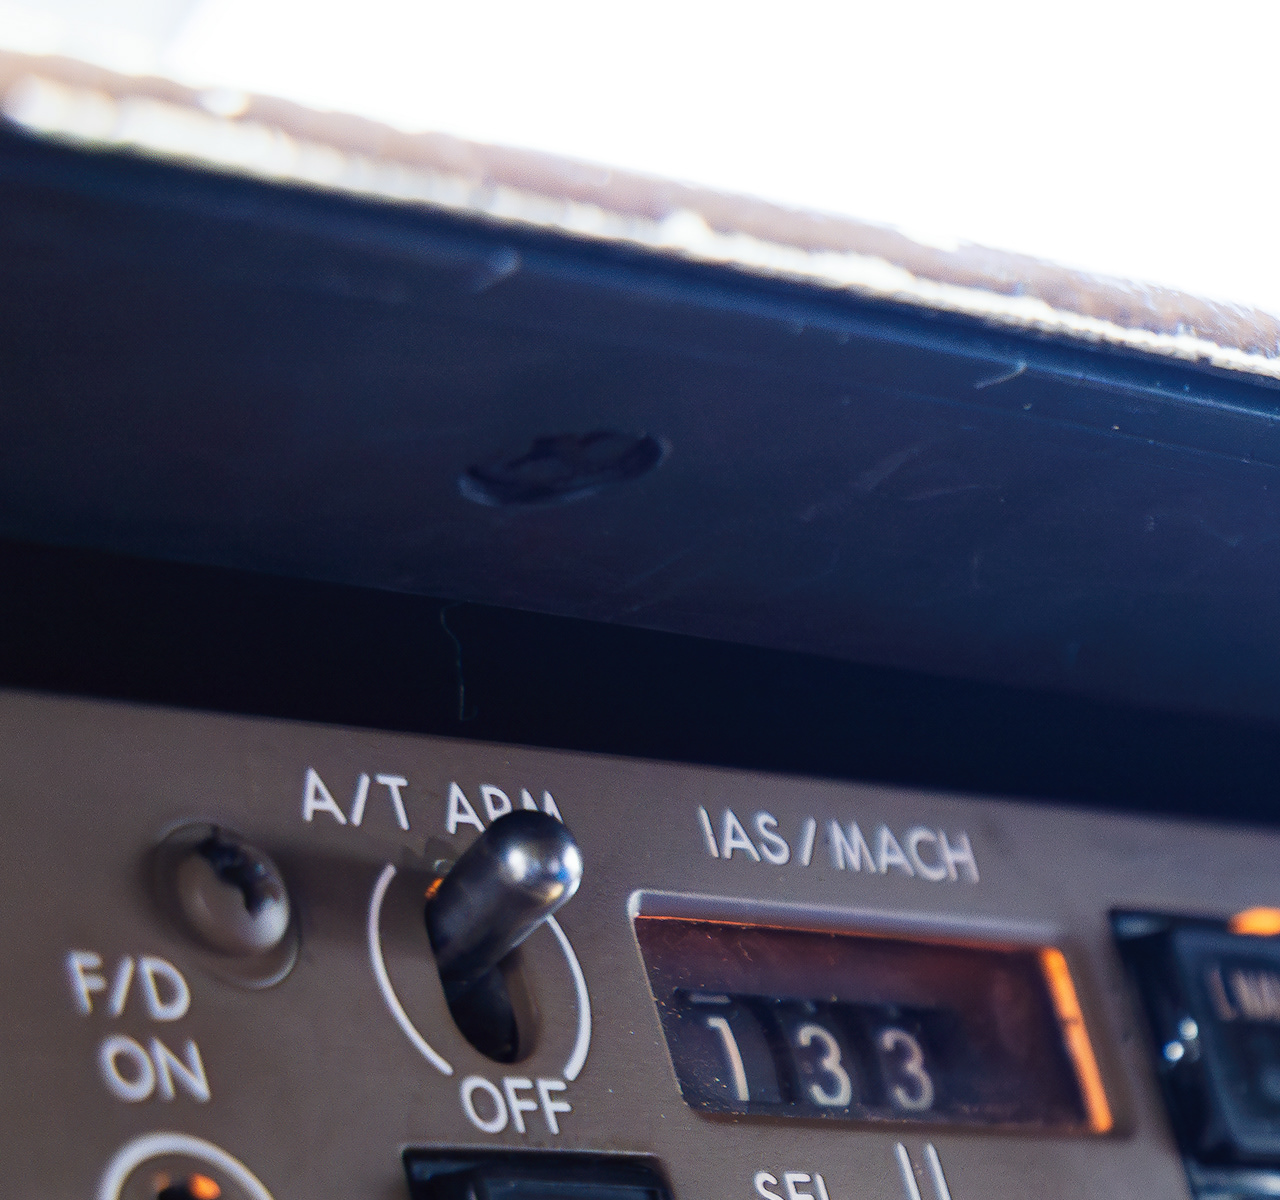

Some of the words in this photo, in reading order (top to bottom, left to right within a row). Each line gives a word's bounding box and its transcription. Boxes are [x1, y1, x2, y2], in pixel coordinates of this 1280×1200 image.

[302, 767, 410, 831] A/T
[66, 950, 190, 1021] F/D
[100, 1034, 211, 1102] ON
[707, 1016, 935, 1111] 133
[460, 1075, 572, 1135] OFF
